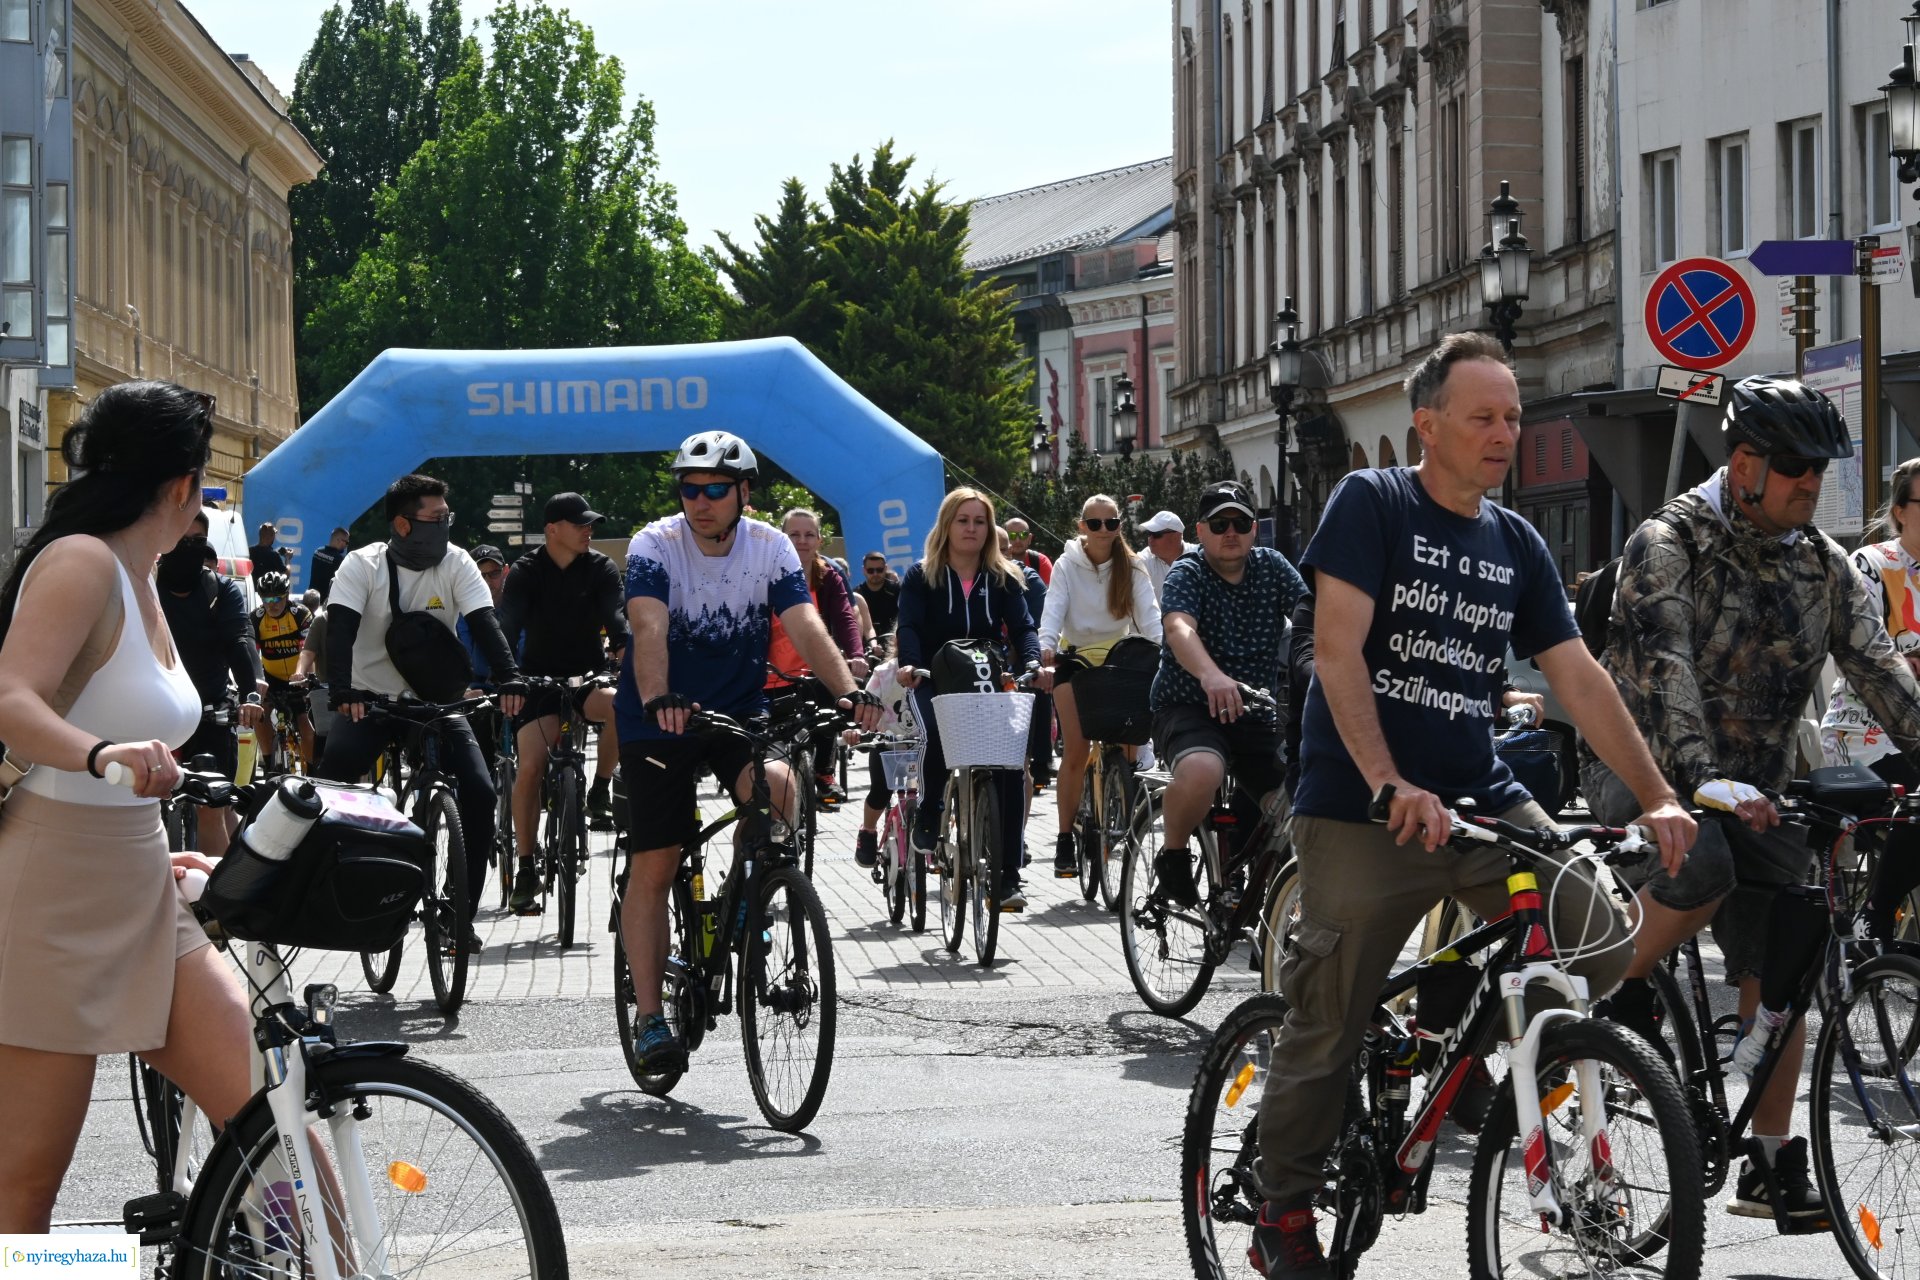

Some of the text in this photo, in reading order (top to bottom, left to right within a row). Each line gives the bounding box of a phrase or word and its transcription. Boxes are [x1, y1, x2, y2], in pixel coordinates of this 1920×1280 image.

[467, 376, 708, 416] SHIMANO
[1414, 534, 1514, 585] Ezt a szar
[1391, 578, 1449, 616] pólót
[1389, 629, 1502, 674] ajándékba a
[380, 891, 406, 904] KLS
